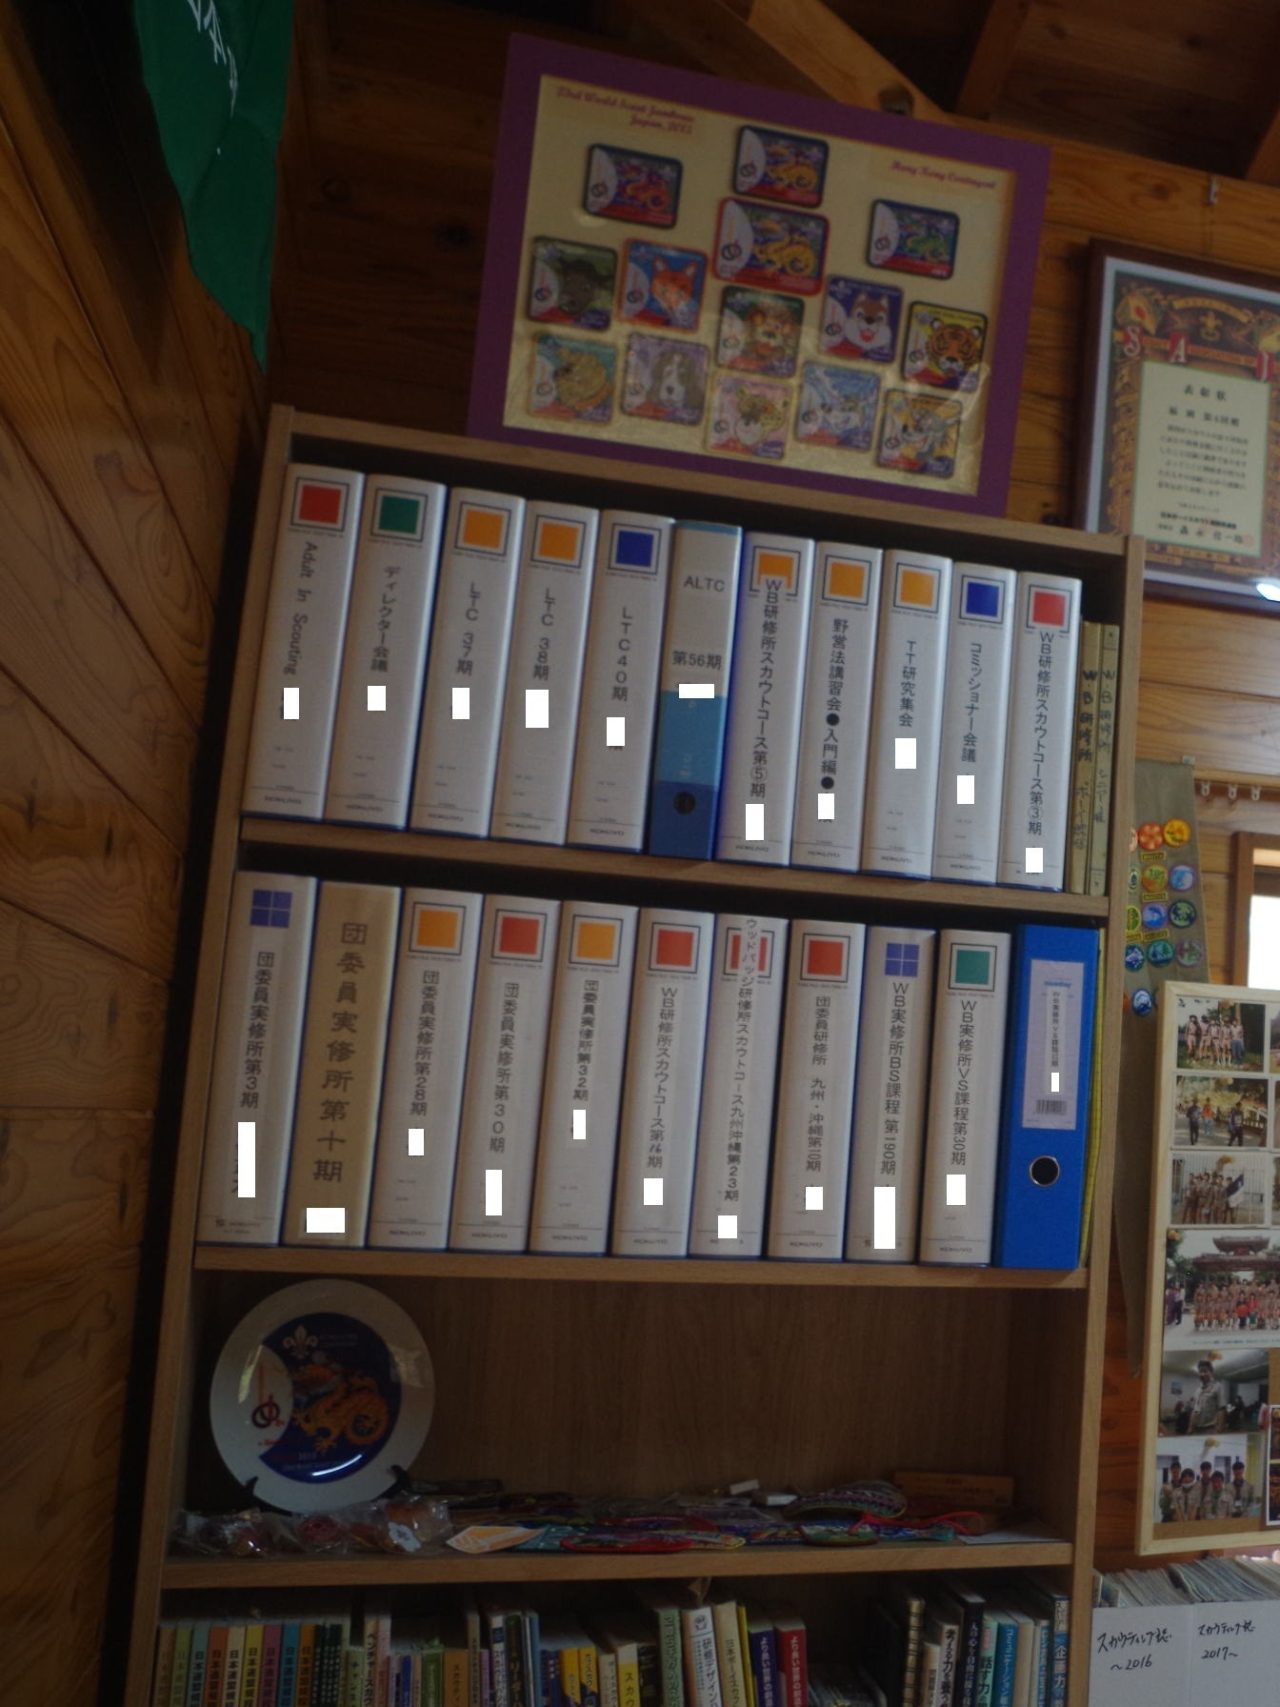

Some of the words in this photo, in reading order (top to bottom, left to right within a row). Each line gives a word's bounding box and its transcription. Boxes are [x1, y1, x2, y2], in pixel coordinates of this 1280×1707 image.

[1170, 338, 1187, 363] A
[300, 541, 319, 579] Adult
[466, 582, 481, 622] LTC
[683, 575, 726, 593] ALTC
[283, 612, 309, 676] Scouting
[370, 566, 401, 674] ディレクター会議
[541, 587, 555, 628] LTC
[672, 650, 722, 671] 第56期
[898, 640, 918, 728] TT研究集会
[960, 642, 984, 764] コミッショナー会議
[240, 951, 276, 1110] 団委員実修所第3期
[312, 921, 369, 1185] 団委員実修所第十期
[409, 970, 440, 1118] 団委員実修所第28期
[488, 982, 520, 1154] 団委員実修所第30期
[572, 979, 599, 1102] 団委員実修所第32期
[812, 995, 832, 1067] 団委員研修所
[949, 1000, 978, 1167] WB実修所VS課程第30期
